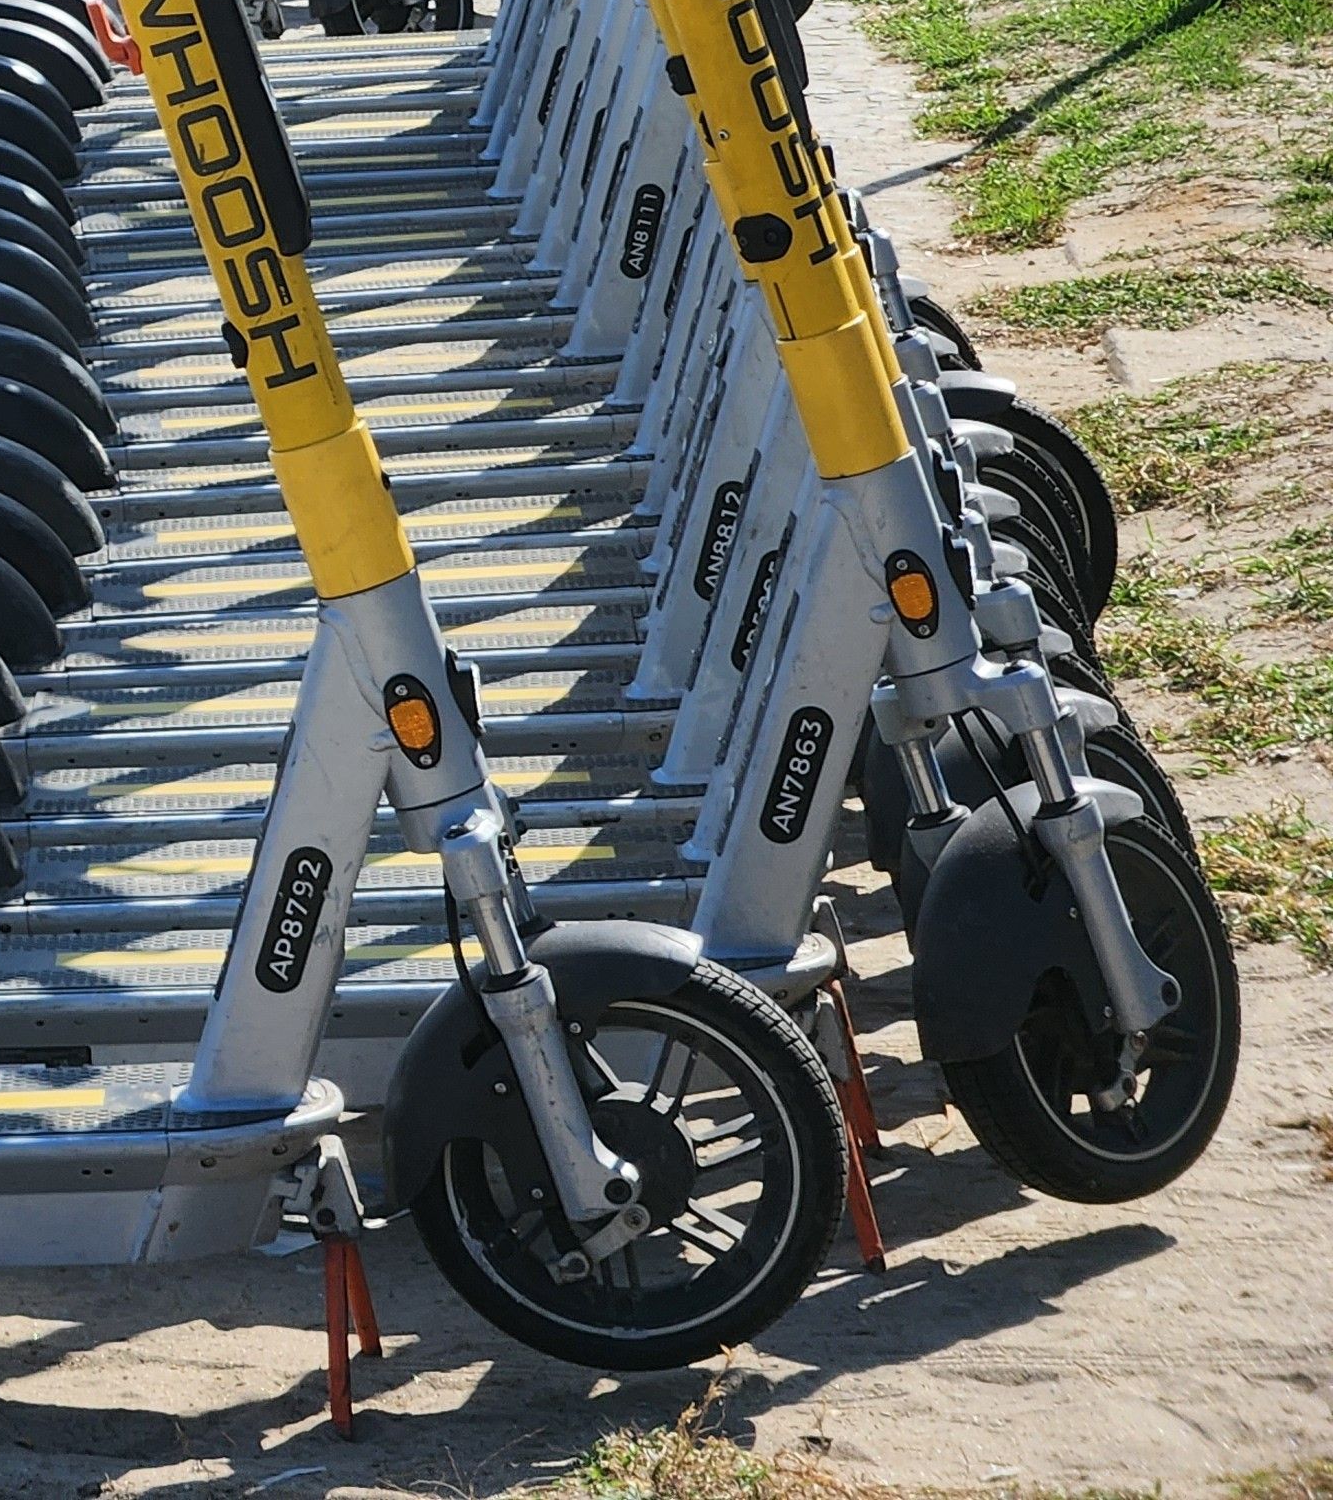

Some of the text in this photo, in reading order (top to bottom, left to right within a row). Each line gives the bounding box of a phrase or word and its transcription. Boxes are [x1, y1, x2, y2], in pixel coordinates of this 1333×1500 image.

[627, 191, 658, 272] AN8111
[704, 490, 744, 589] AN8812
[770, 717, 823, 835] AN7863
[268, 858, 323, 983] AP8792
